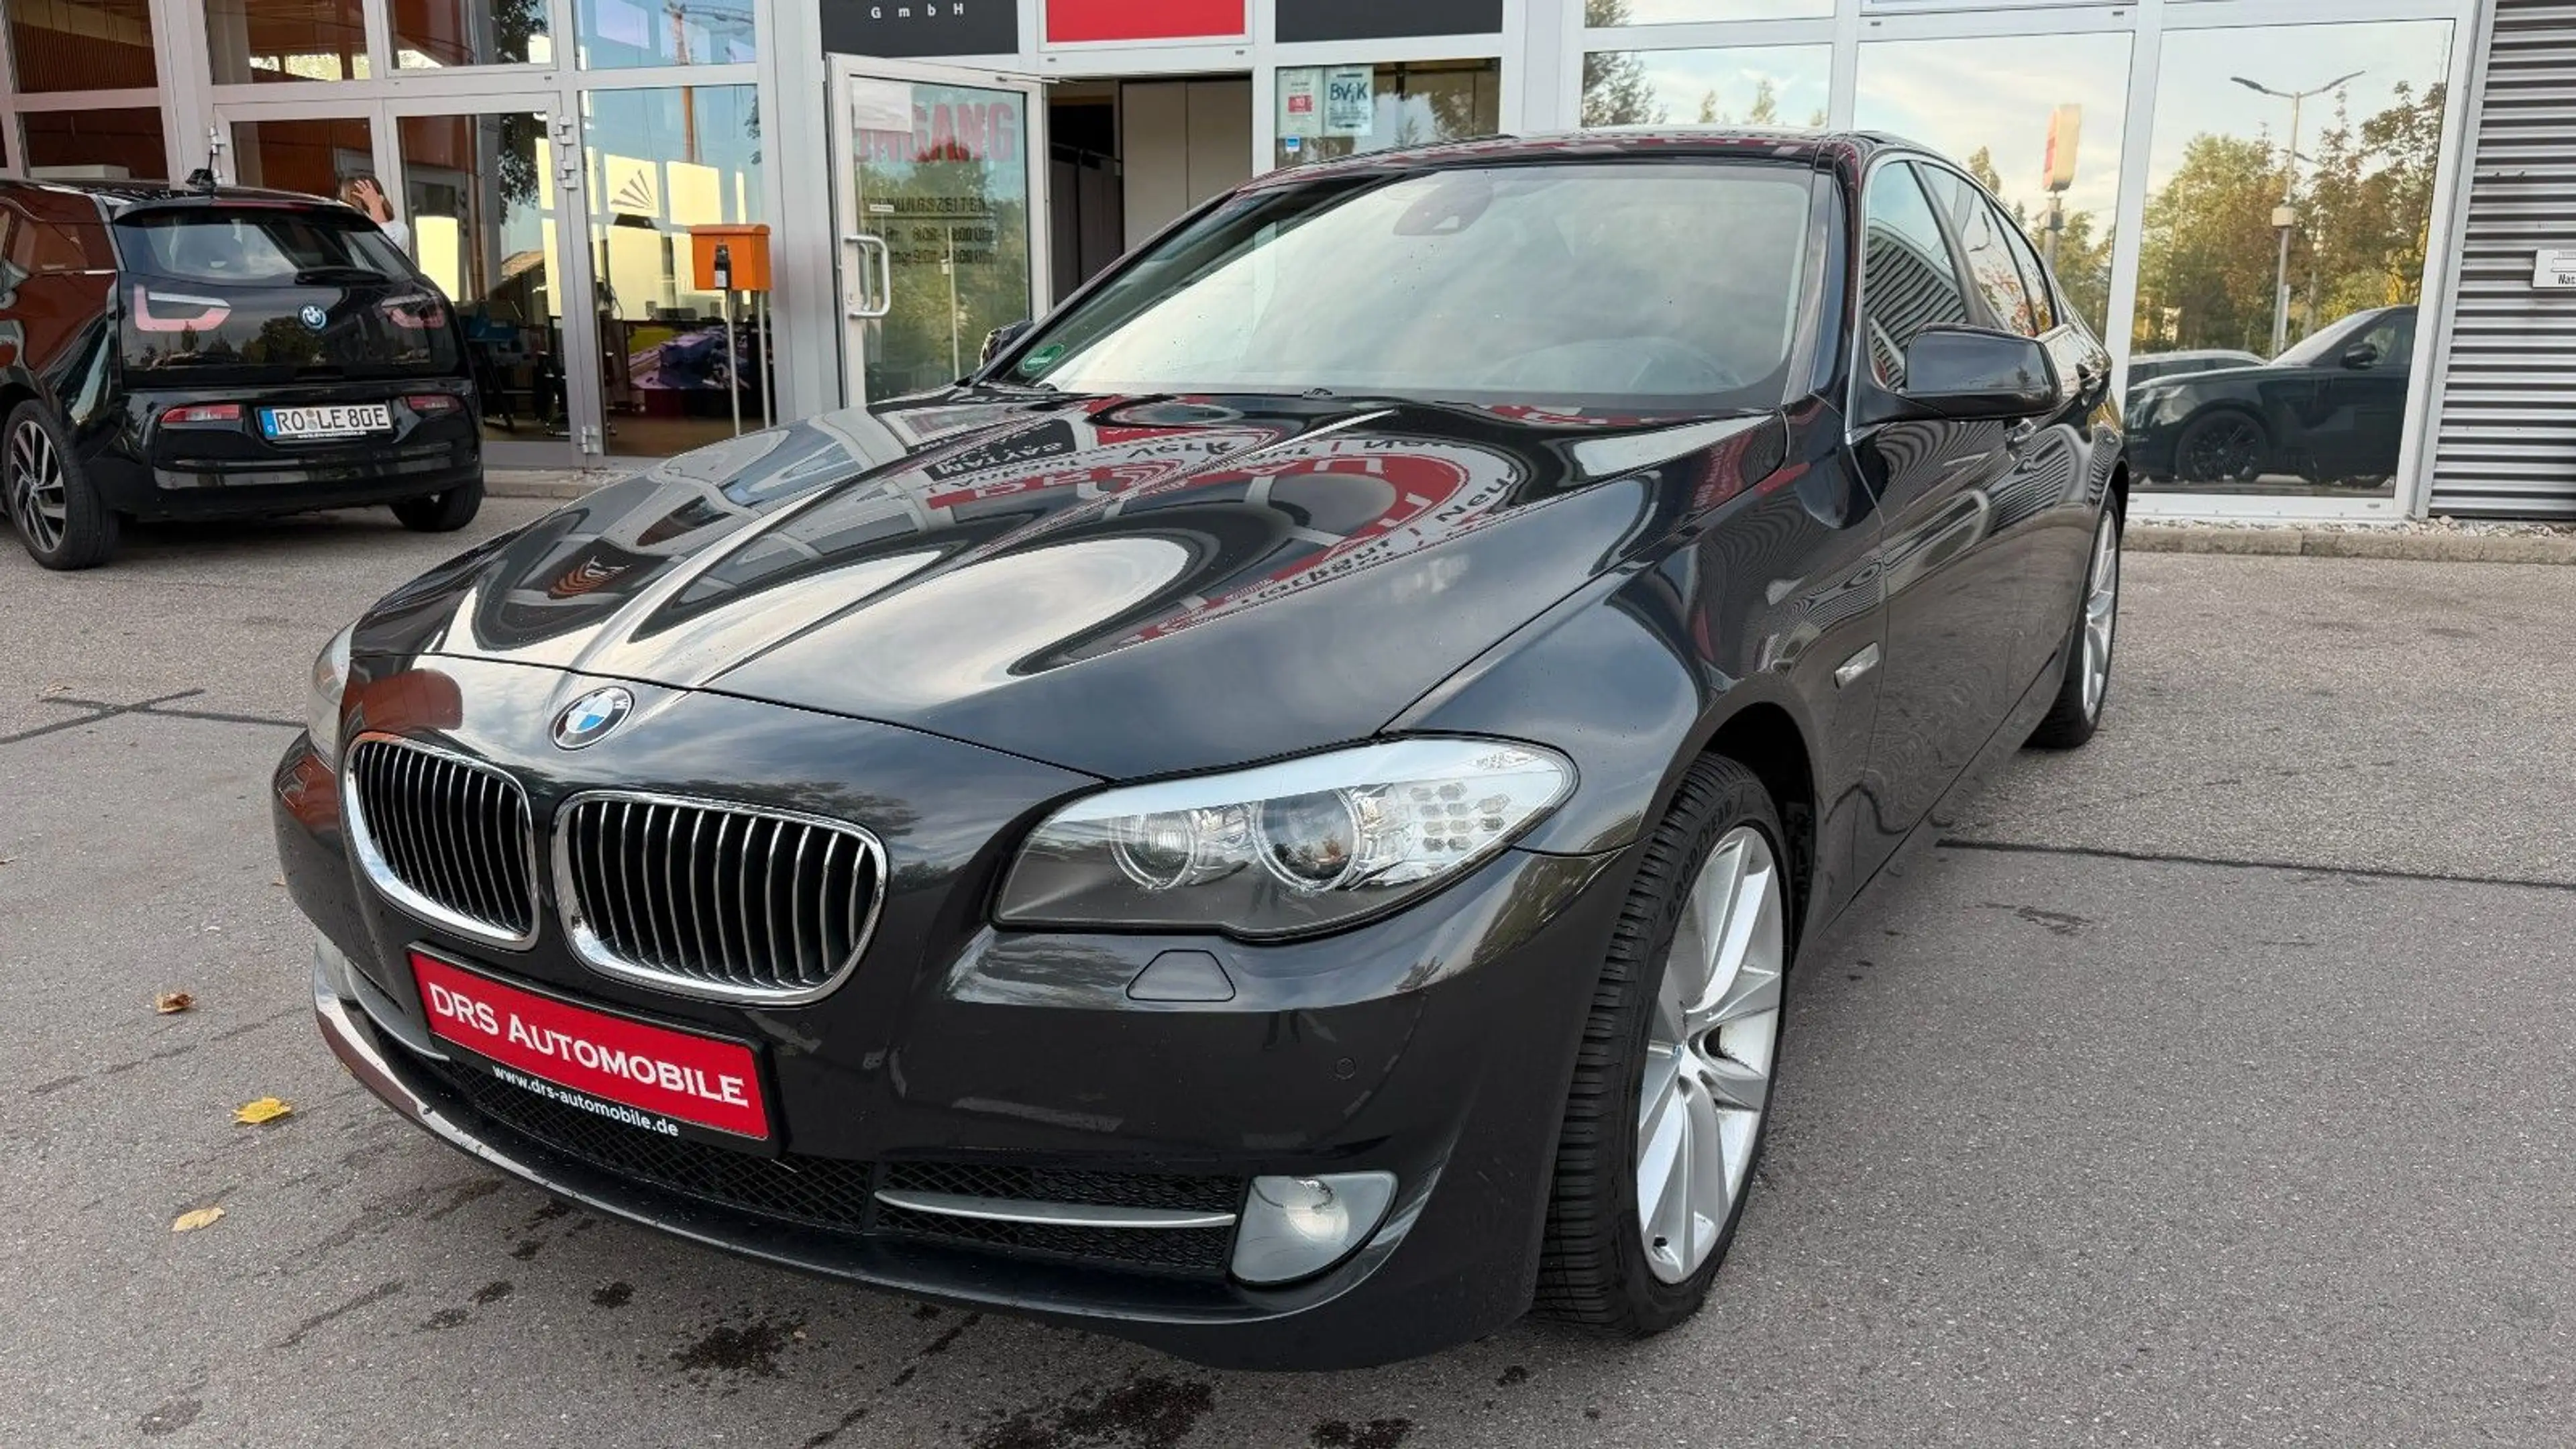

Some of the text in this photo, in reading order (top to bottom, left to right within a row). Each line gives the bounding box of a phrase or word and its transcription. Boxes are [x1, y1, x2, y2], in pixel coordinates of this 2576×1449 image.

[853, 103, 1015, 162] NGANG
[275, 411, 305, 432] RO
[315, 409, 345, 429] LE
[427, 982, 750, 1108] DRS AUTOMOBILE
[492, 1065, 680, 1137] www.drs-automobile.de
